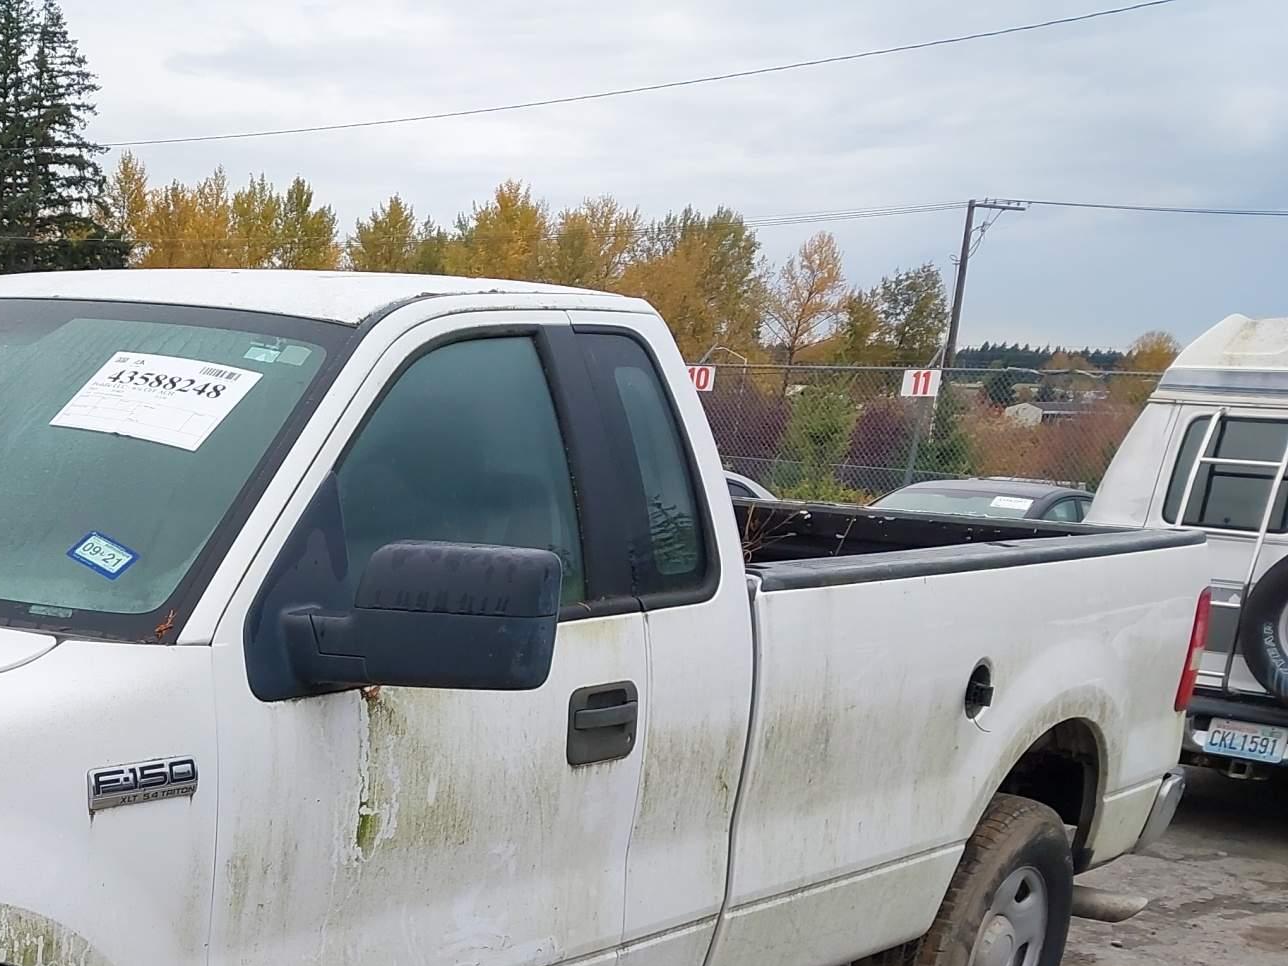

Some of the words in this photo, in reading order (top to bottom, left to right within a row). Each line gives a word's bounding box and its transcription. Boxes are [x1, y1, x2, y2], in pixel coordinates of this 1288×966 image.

[107, 369, 227, 399] 43588248
[688, 367, 710, 389] 10
[913, 371, 931, 395] 11
[82, 542, 102, 556] 09
[102, 553, 123, 567] 21
[1209, 729, 1278, 756] CKL1591
[94, 758, 195, 795] F-150
